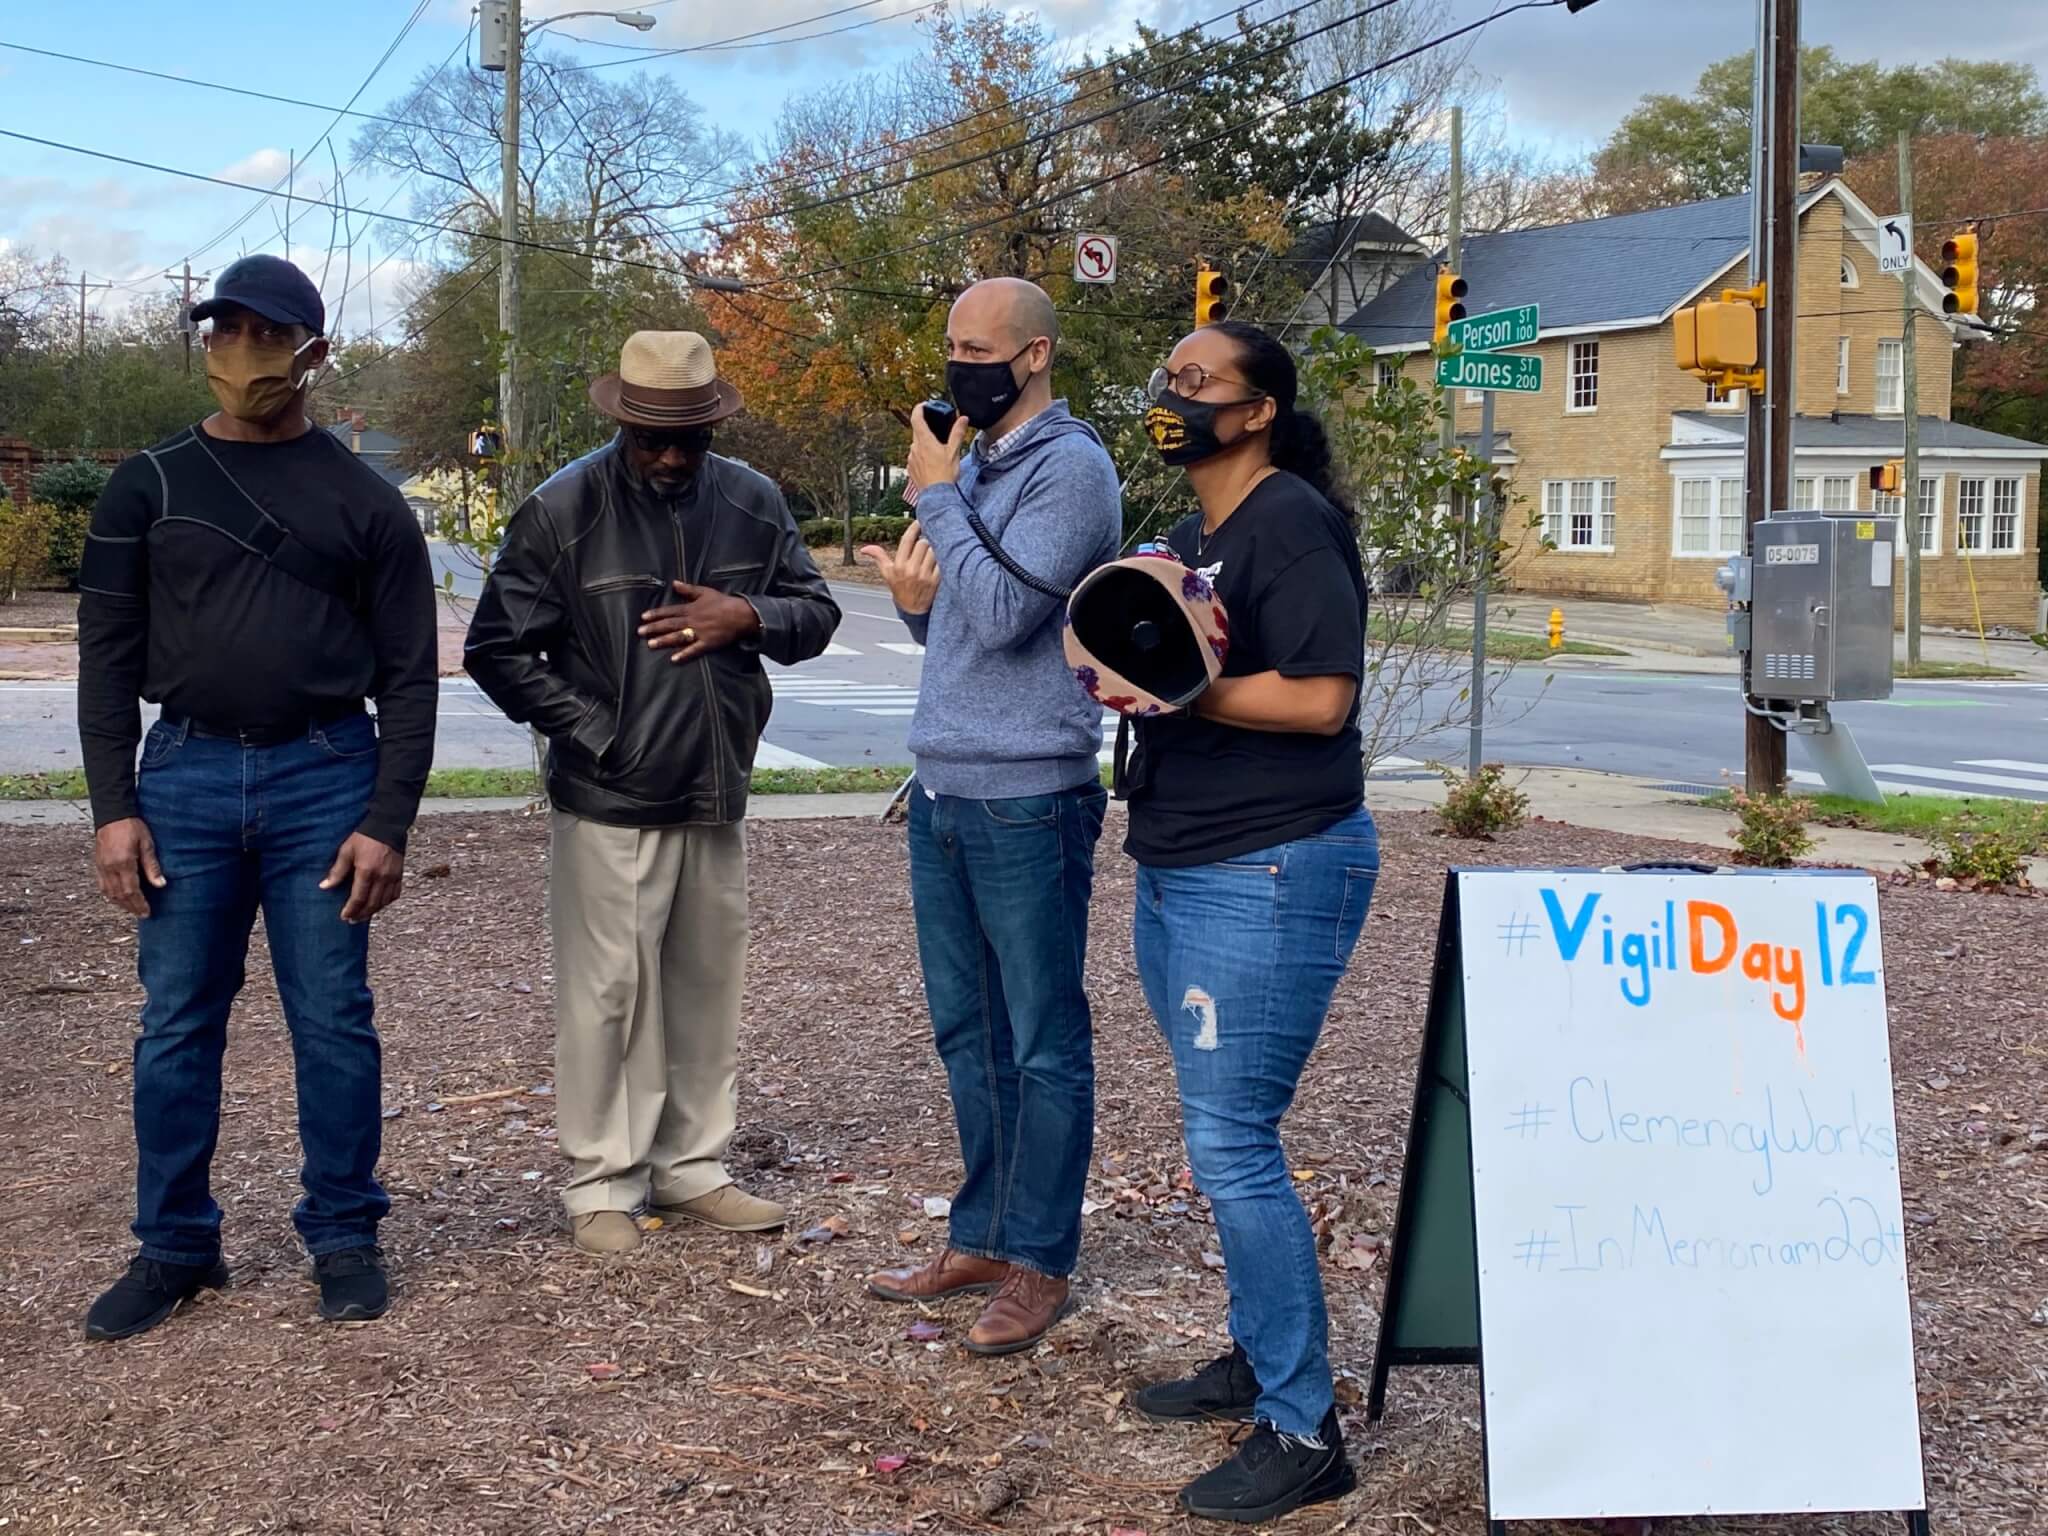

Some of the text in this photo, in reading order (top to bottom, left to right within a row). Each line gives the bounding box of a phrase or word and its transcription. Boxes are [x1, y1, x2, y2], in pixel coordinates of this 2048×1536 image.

[1882, 255, 1909, 269] ONLY
[1463, 320, 1511, 348] Person
[1519, 308, 1531, 324] ST
[1516, 325, 1533, 341] 100
[1440, 355, 1534, 385] E Jones ST
[1516, 374, 1537, 389] 200
[1768, 548, 1817, 562] 05-0075
